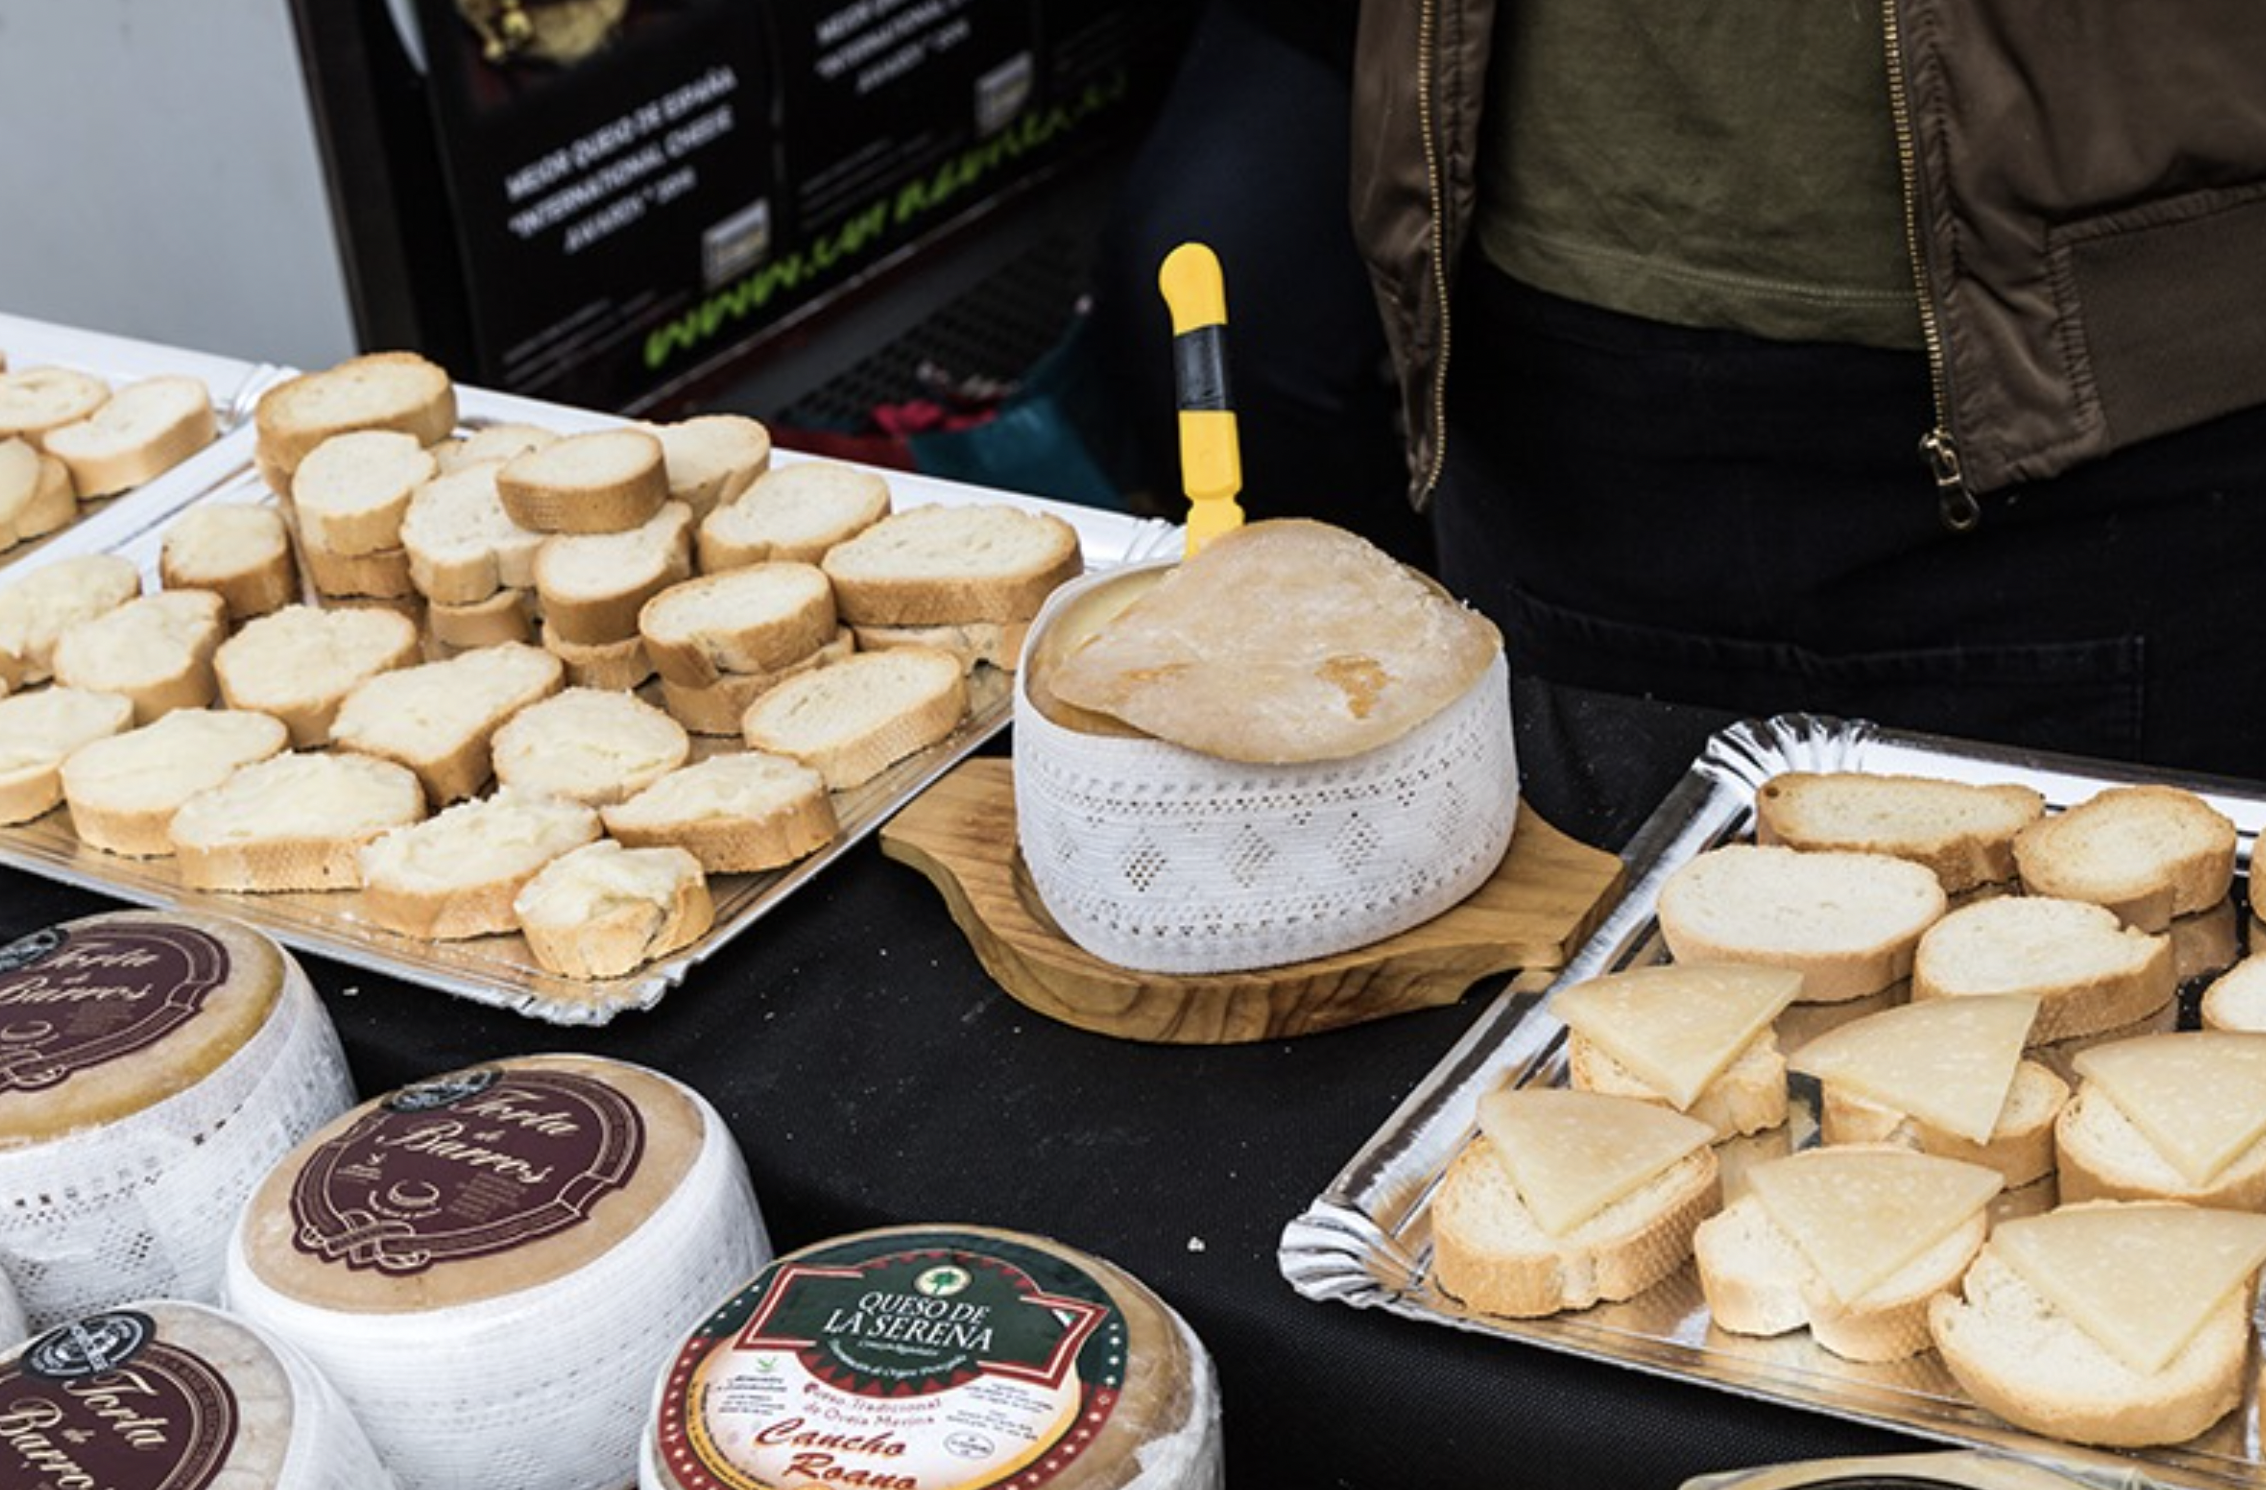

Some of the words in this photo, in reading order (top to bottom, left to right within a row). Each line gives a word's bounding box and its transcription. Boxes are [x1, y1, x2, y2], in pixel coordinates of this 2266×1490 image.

[505, 148, 571, 202] MEJOR
[571, 115, 635, 168] QUESO
[634, 101, 663, 135] DE
[449, 1090, 580, 1136] Torta
[375, 1119, 554, 1183] Barros
[822, 1308, 865, 1336] LA
[866, 1314, 993, 1351] SERENA
[858, 1291, 949, 1319] QUESO
[949, 1301, 992, 1326] DE
[62, 1370, 168, 1451] Torta
[852, 1397, 942, 1413] Tradicional
[0, 1398, 113, 1490] Barro
[755, 1417, 907, 1457] Cancho
[782, 1452, 918, 1490] Roano
